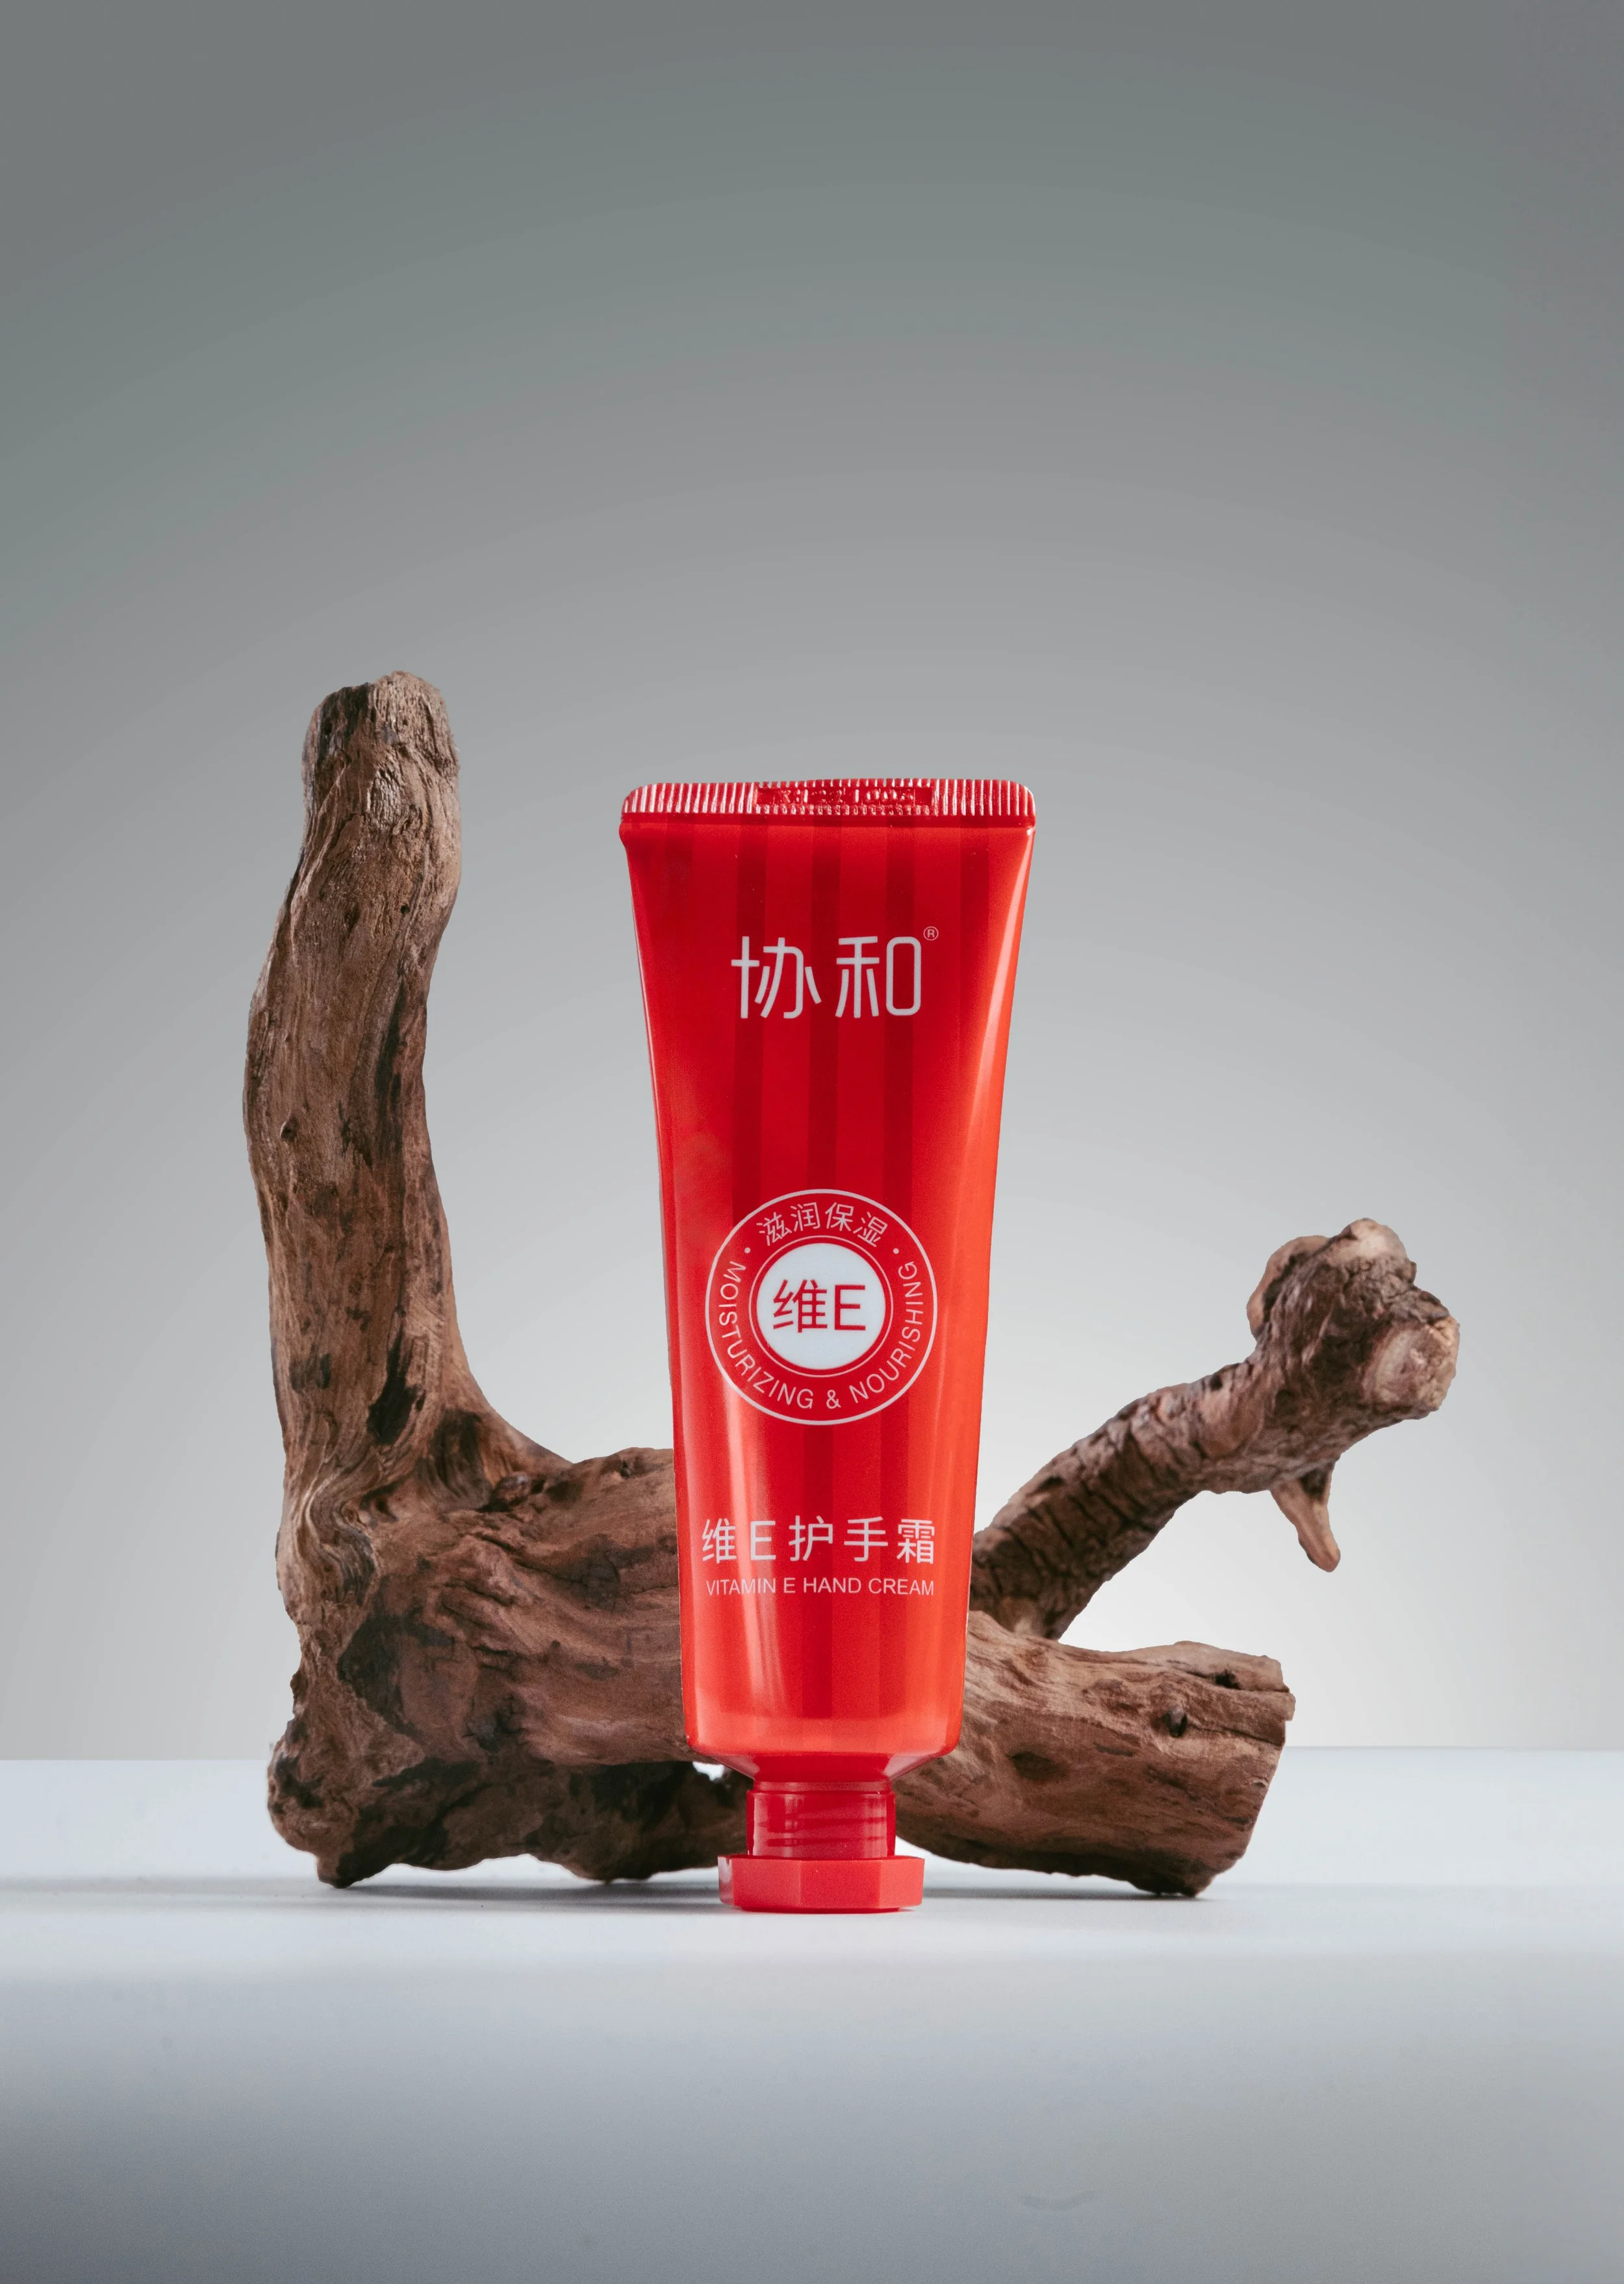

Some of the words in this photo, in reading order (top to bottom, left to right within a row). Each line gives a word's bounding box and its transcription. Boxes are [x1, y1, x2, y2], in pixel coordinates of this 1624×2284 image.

[731, 936, 921, 1019] 协和
[756, 1202, 888, 1248] 滋润保湿
[772, 1279, 867, 1333] 维E
[718, 1261, 814, 1409] MOISTURIZING
[826, 1389, 841, 1409] &
[849, 1261, 924, 1403] NOURISHING
[706, 1577, 776, 1596] VITAMIN
[783, 1577, 796, 1594] E
[803, 1577, 862, 1595] HAND
[868, 1578, 935, 1596] CREAM
